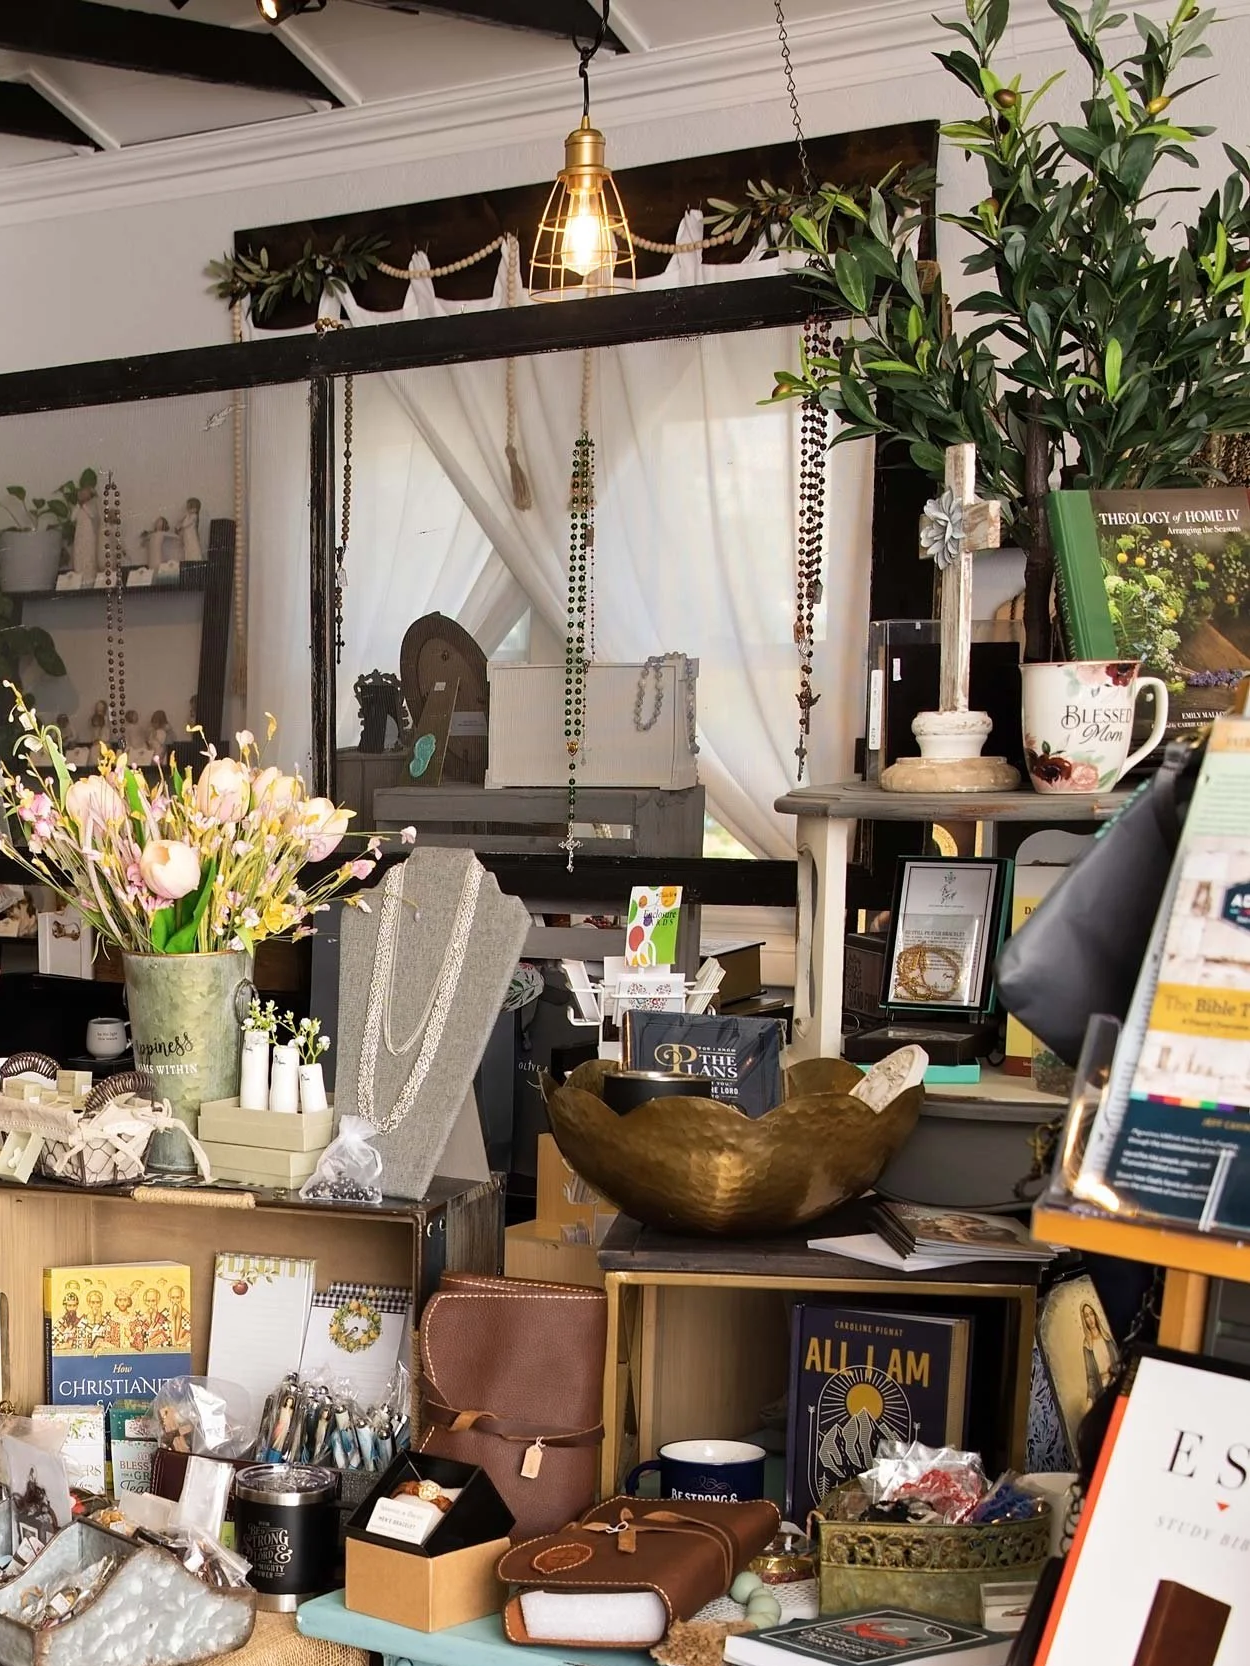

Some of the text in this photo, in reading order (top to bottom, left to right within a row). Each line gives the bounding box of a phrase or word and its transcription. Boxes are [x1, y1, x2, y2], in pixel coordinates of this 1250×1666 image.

[1099, 508, 1240, 525] THEOLOGY of HOME IV
[1167, 524, 1241, 536] Arranging the Seasons
[1060, 704, 1132, 730] BLESSED
[1181, 711, 1198, 720] EMILY
[1079, 724, 1123, 745] Mom
[643, 909, 676, 919] Enclosure
[1164, 994, 1192, 1012] The
[1195, 998, 1237, 1016] Bible
[155, 1063, 198, 1075] WITHIN
[699, 1054, 737, 1067] THE
[720, 1086, 739, 1095] LORD
[834, 1320, 903, 1337] CAROLINE PIGNAT
[112, 1362, 133, 1374] How
[805, 1336, 930, 1388] ALL I AM
[119, 1460, 150, 1471] BLESS
[1164, 1428, 1250, 1490] ES
[1154, 1515, 1250, 1553] STUDY BIB
[240, 1529, 289, 1560] STRONG
[274, 1544, 293, 1564] &
